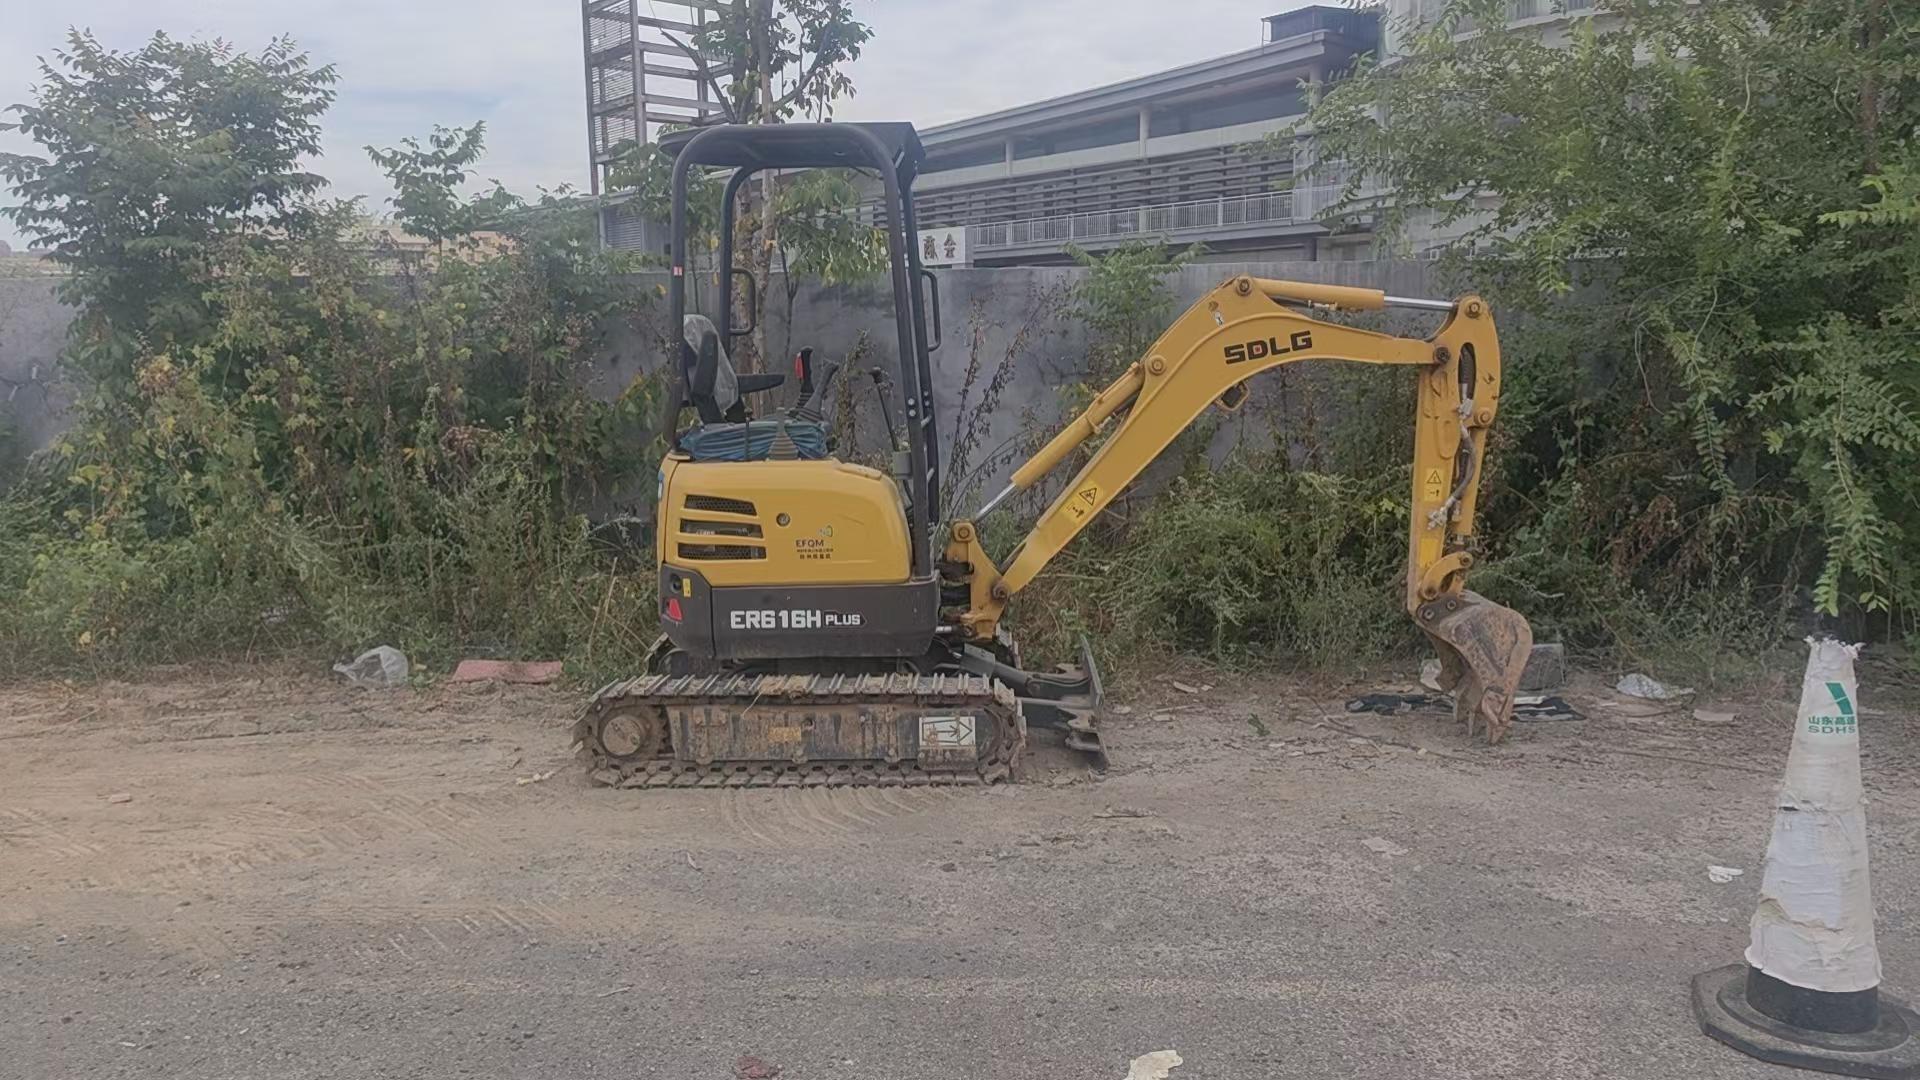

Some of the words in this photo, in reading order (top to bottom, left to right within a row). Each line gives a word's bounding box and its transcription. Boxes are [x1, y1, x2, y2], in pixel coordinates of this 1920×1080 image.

[1224, 330, 1312, 364] SDLG
[730, 610, 821, 629] ER616H
[825, 614, 860, 625] PLUS
[1808, 725, 1855, 733] SDHS
